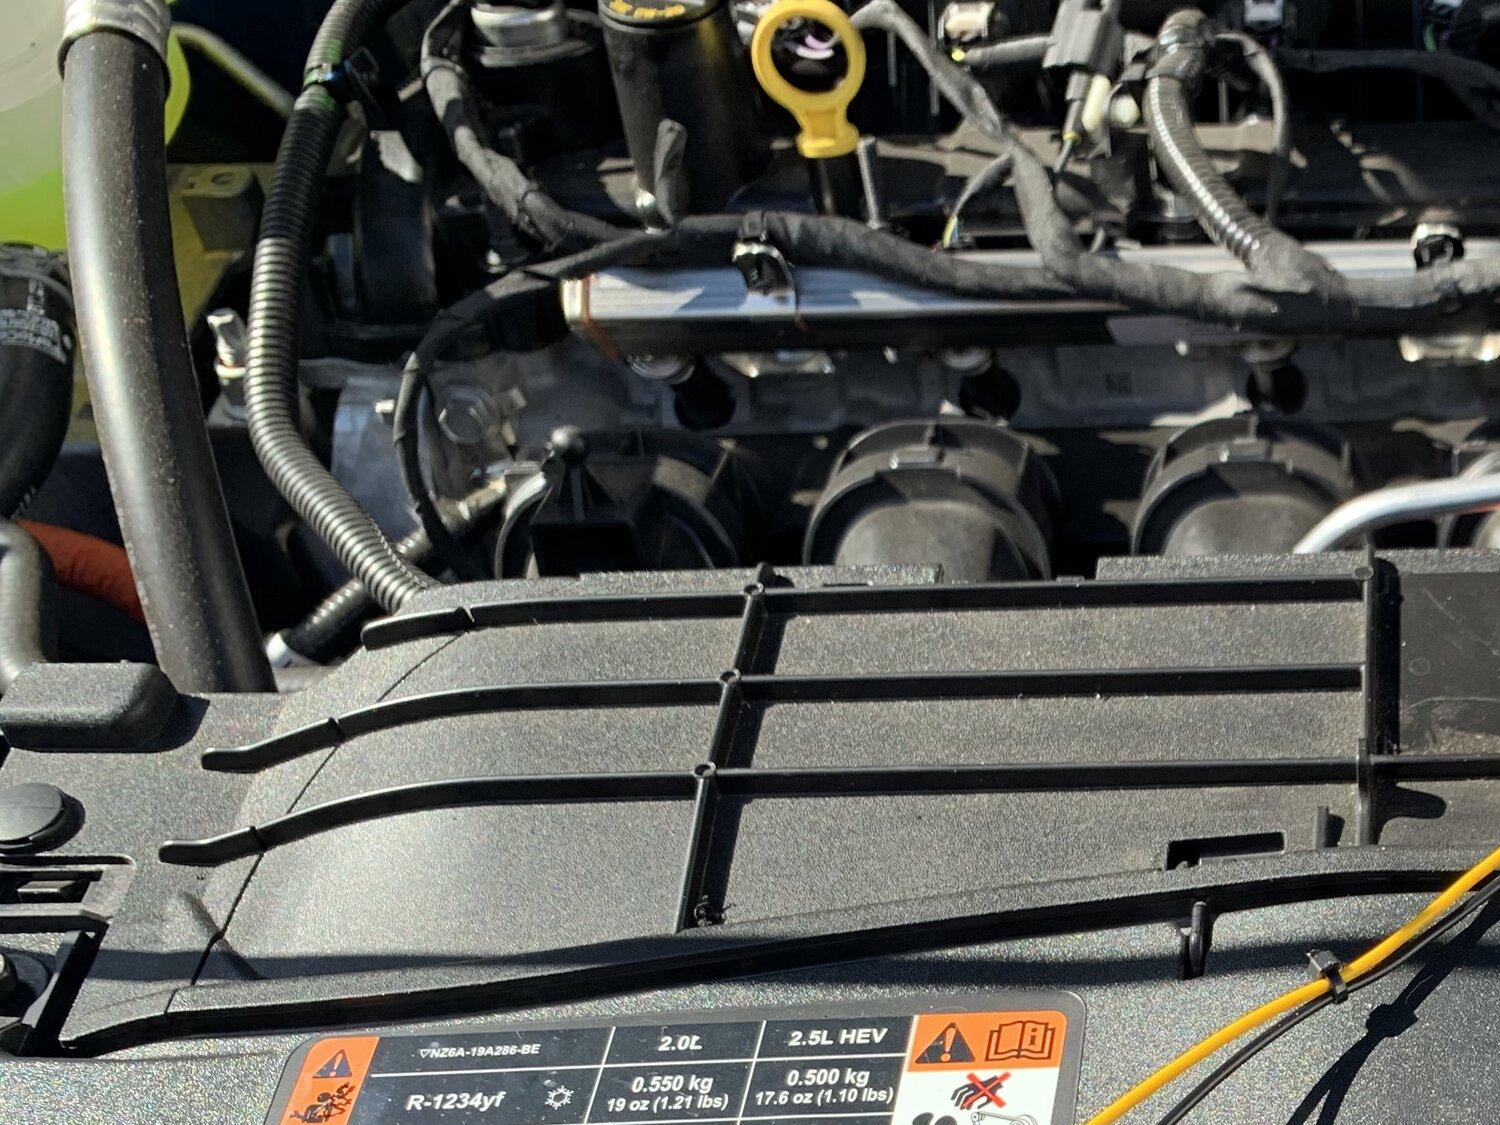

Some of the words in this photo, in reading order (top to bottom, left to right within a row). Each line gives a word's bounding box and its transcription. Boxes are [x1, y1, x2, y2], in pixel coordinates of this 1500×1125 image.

[658, 1035, 702, 1050] 2.0L
[789, 1030, 833, 1046] 2.5L
[840, 1028, 888, 1044] HEV
[632, 1076, 684, 1093] 0.550
[688, 1075, 714, 1094] kg
[787, 1070, 840, 1086] 0.500
[845, 1068, 870, 1087] kg
[406, 1091, 506, 1111] R-1234yf
[607, 1098, 626, 1112] 19
[628, 1100, 648, 1111] oz
[653, 1096, 692, 1113] (1.21
[697, 1094, 729, 1111] lbs)
[755, 1091, 788, 1106] 17.6
[794, 1093, 813, 1105] oz
[817, 1089, 858, 1107] (1.10
[862, 1087, 894, 1105] lbs)
